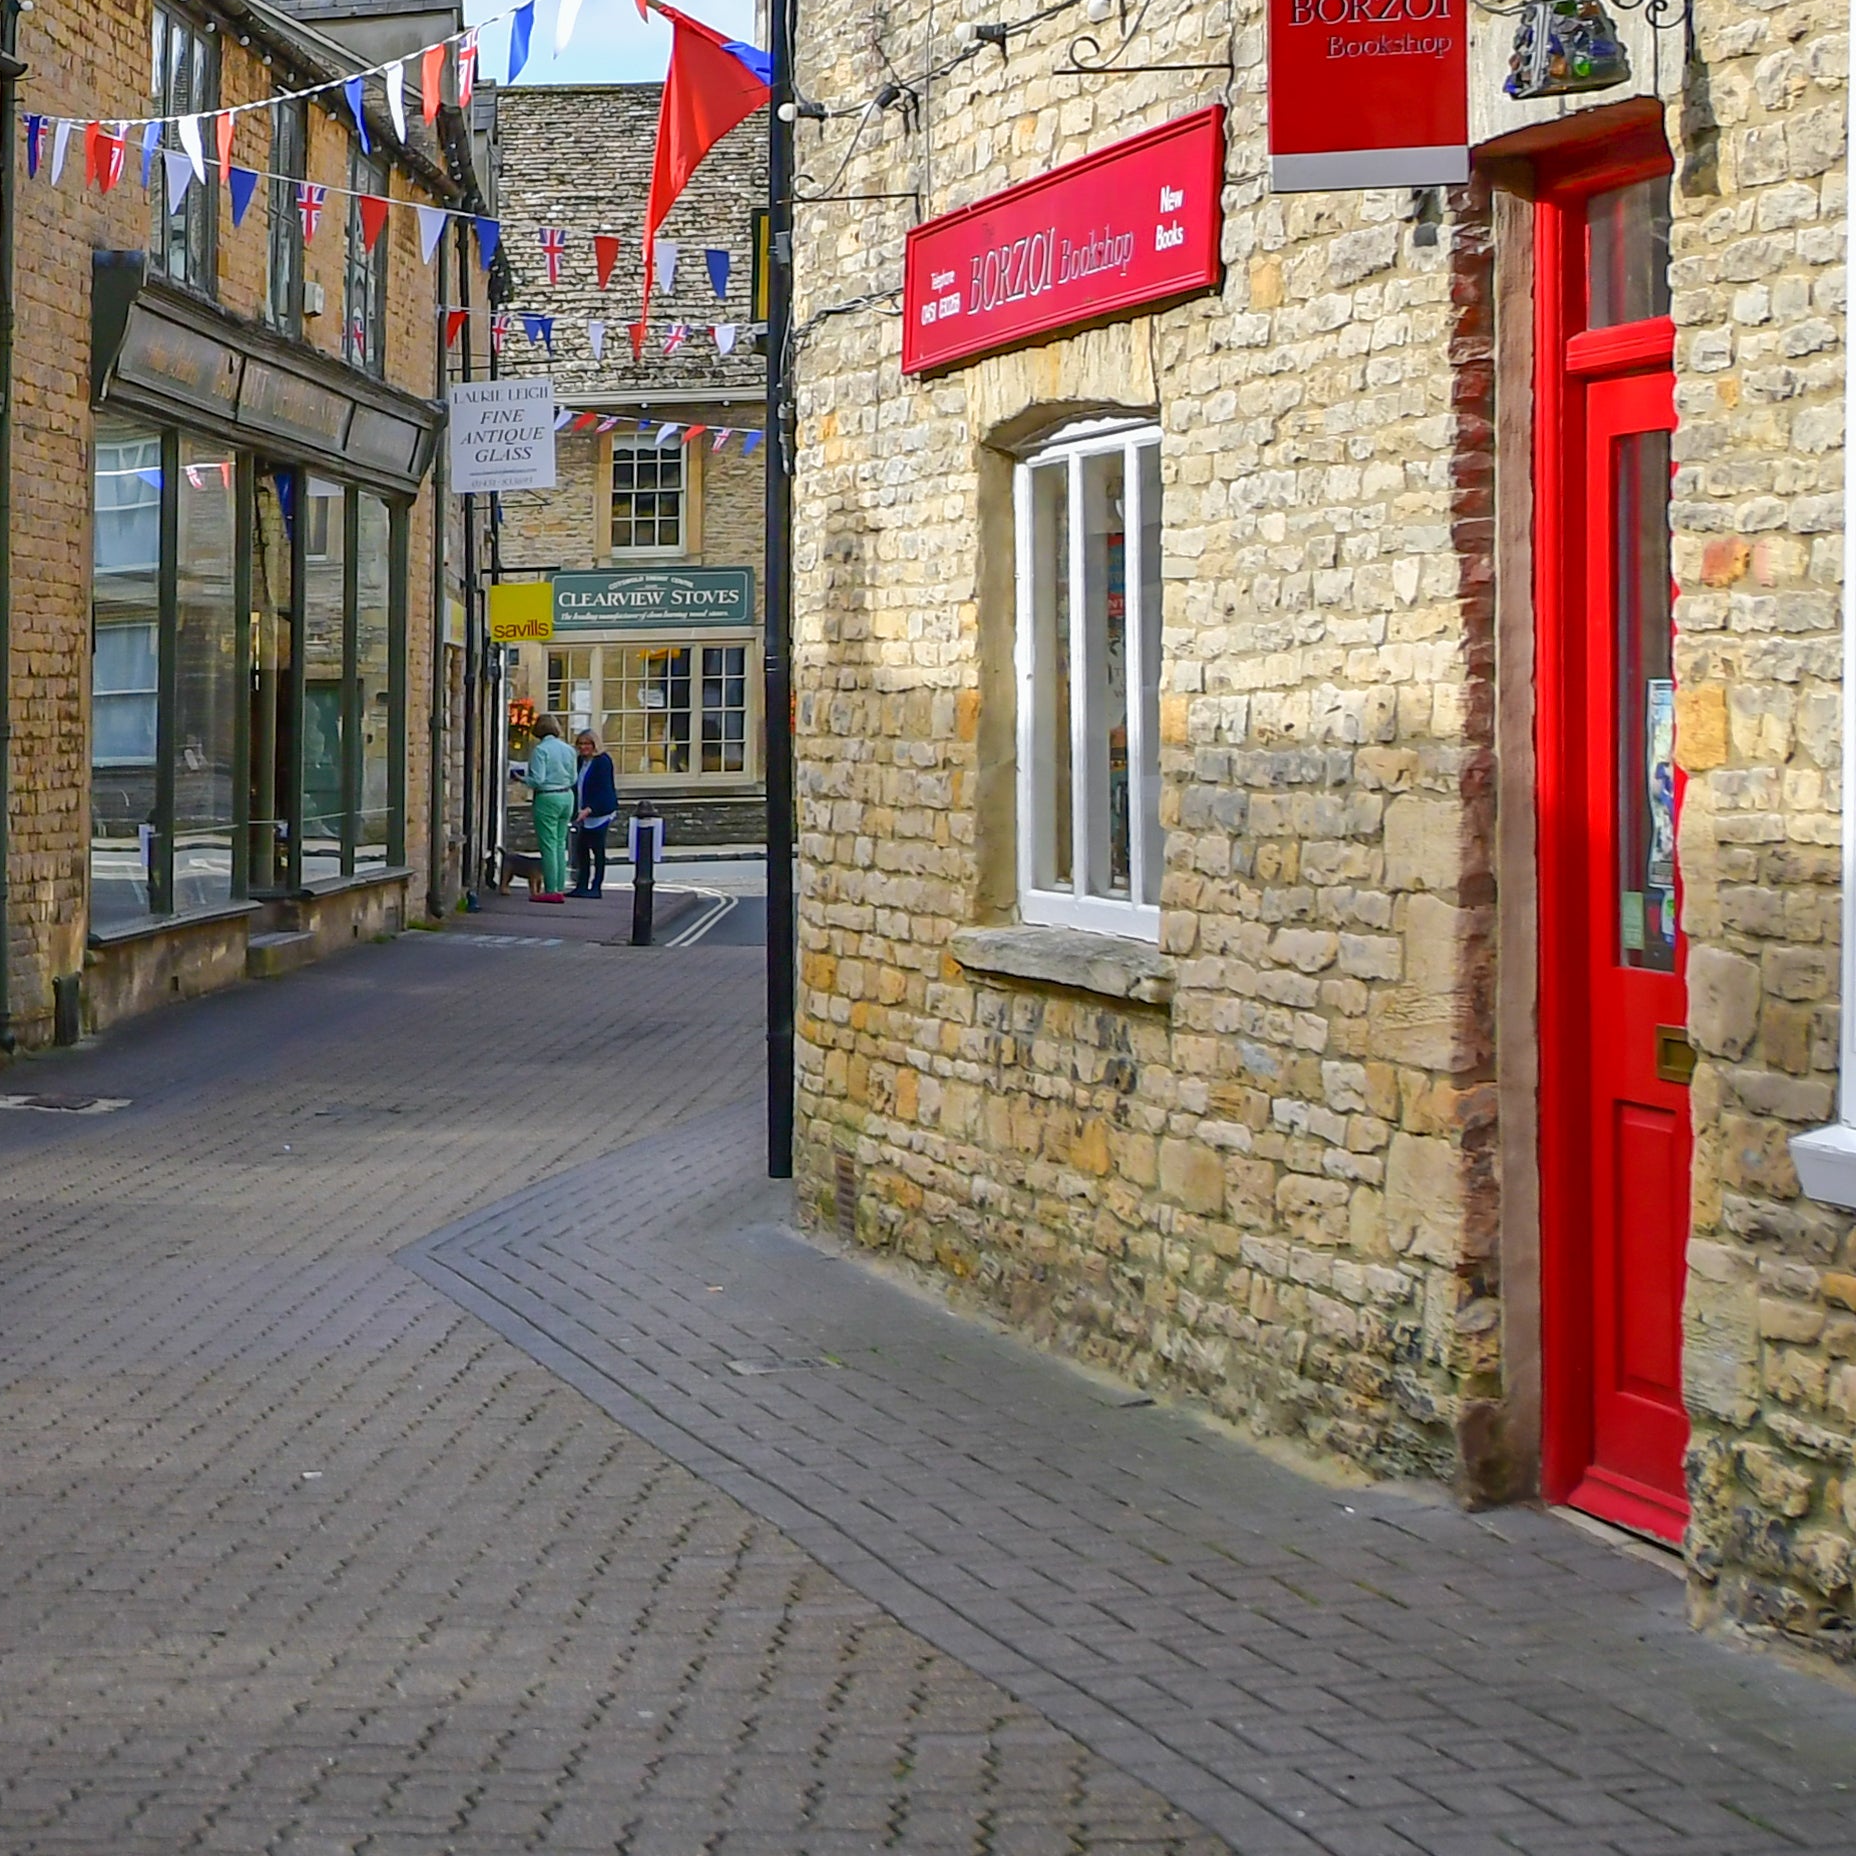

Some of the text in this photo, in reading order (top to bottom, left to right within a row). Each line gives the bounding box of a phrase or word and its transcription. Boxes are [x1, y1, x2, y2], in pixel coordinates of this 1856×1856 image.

[1326, 32, 1453, 60] Bookshop
[1159, 184, 1185, 215] New
[1155, 220, 1185, 253] Books
[967, 227, 1057, 316] BORZOI
[1058, 223, 1135, 285] Bookshop
[454, 386, 548, 404] LAURIE LEIGH
[480, 408, 526, 425] FINE
[460, 426, 546, 446] ANTIQUE
[475, 447, 533, 463] GLASS
[558, 588, 740, 609] CLEARVIEW STOVES
[494, 619, 550, 639] savills
